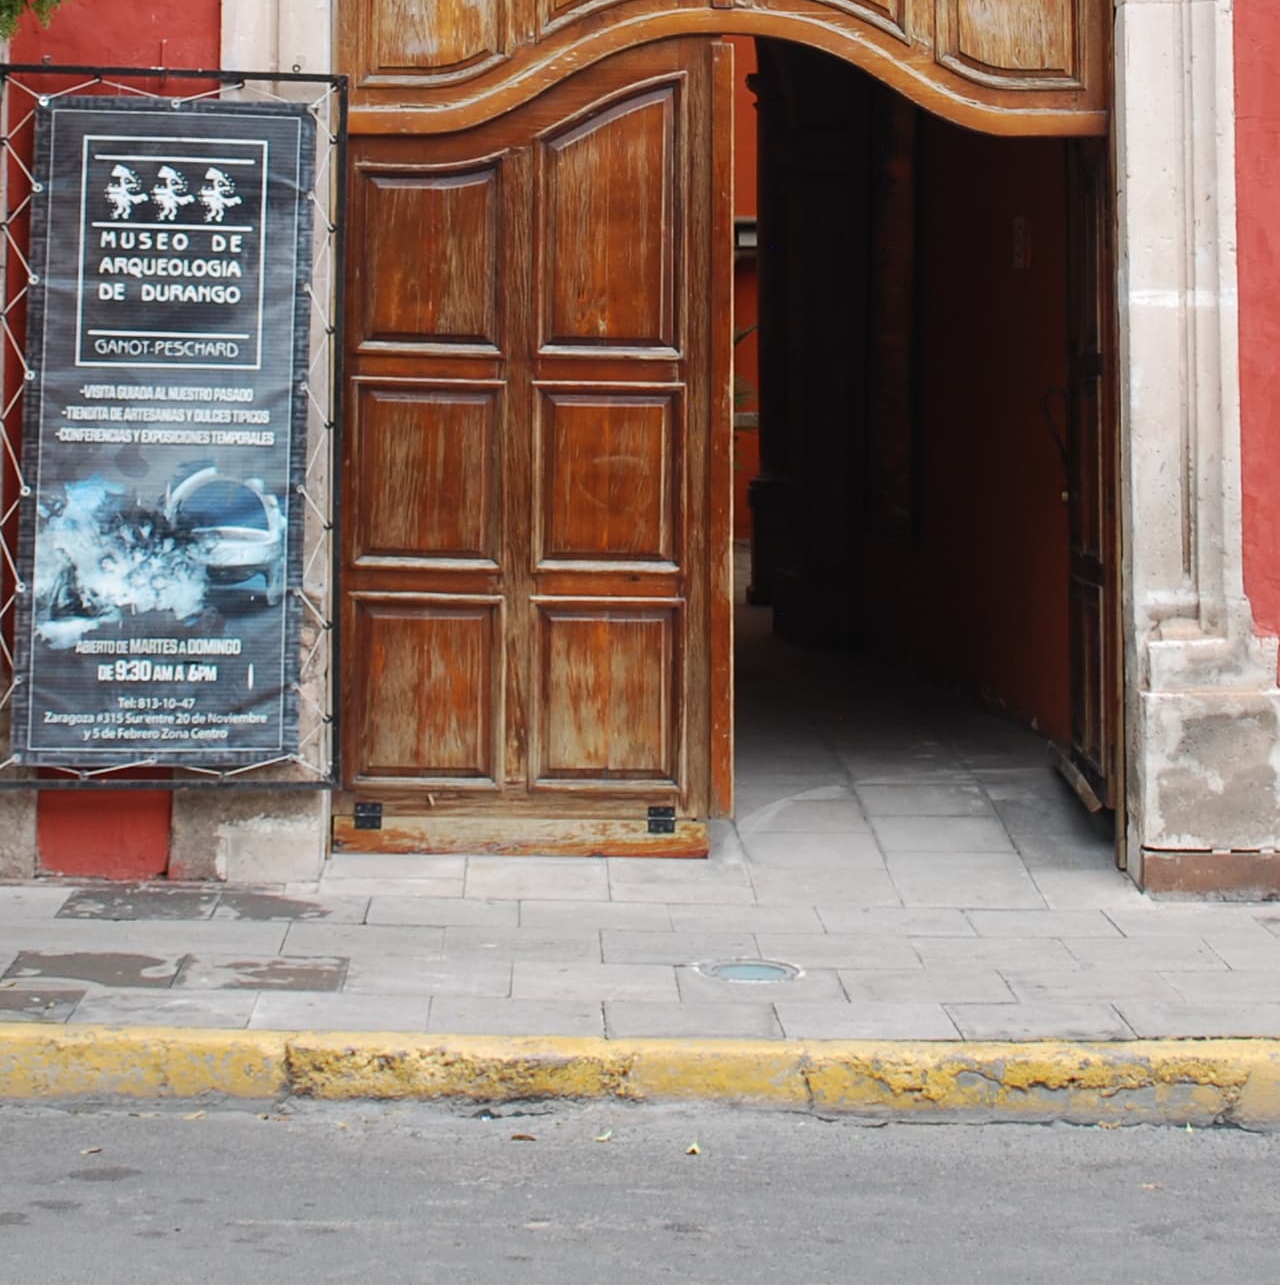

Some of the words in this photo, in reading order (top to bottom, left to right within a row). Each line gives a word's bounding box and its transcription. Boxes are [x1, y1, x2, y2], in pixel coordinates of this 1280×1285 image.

[100, 231, 189, 251] MUSEO
[211, 234, 243, 253] DE
[99, 256, 242, 278] ARQUEOLOGIA
[98, 282, 126, 301] DE
[141, 283, 241, 304] DURANGO
[94, 338, 239, 358] GANOT-PESCHARD
[154, 386, 166, 400] AL
[167, 386, 213, 401] NUESTRO
[213, 387, 253, 402] PASADO
[109, 406, 124, 421] DE
[185, 409, 194, 422] Y
[193, 409, 232, 423] DULCES
[132, 429, 141, 443] Y
[141, 429, 210, 444] EXPOSICIONES
[210, 430, 275, 445] TEMPORALES
[75, 639, 115, 654] ABIERTO
[116, 640, 129, 654] DE
[129, 638, 178, 654] MARTES
[178, 640, 187, 654] A
[187, 638, 242, 655] DOMINGO
[97, 664, 114, 681] DE
[152, 665, 174, 681] AM
[174, 665, 184, 681] A
[44, 711, 95, 726] Zaragoza
[96, 712, 124, 723] #315
[124, 712, 144, 724] Sur
[144, 713, 174, 724] entre
[175, 712, 191, 724] 20
[191, 712, 206, 724] de
[207, 711, 268, 723] Noviembre
[82, 729, 91, 741] y
[92, 727, 100, 739] 5
[101, 727, 116, 739] de
[117, 727, 160, 739] Febrero
[160, 728, 189, 739] Zona
[190, 727, 228, 739] Centro
